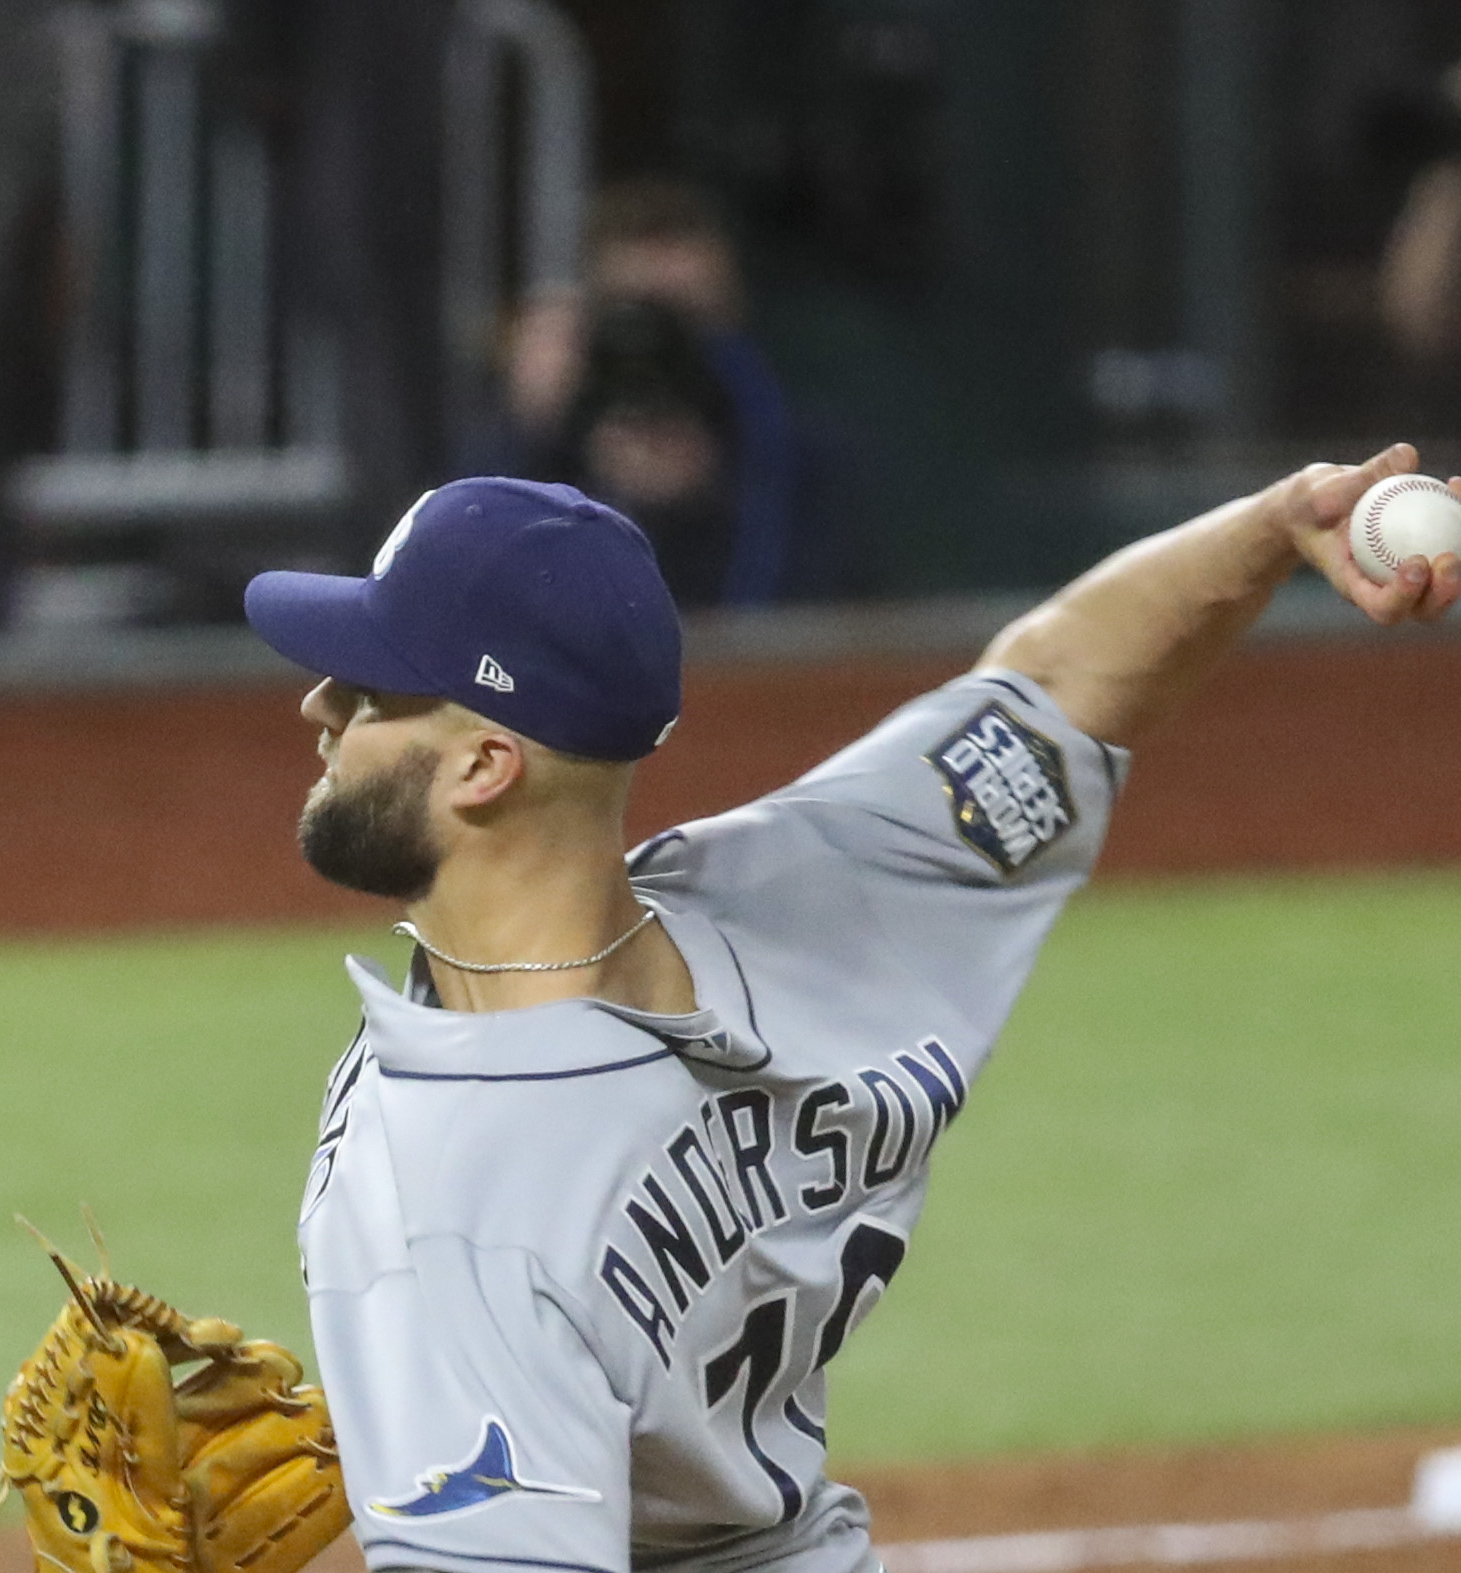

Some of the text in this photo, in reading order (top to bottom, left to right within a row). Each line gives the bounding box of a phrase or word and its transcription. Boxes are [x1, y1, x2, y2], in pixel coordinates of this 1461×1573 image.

[941, 737, 1038, 867] WORLD
[965, 713, 1071, 843] SERIES
[597, 1034, 968, 1378] ANDRSON
